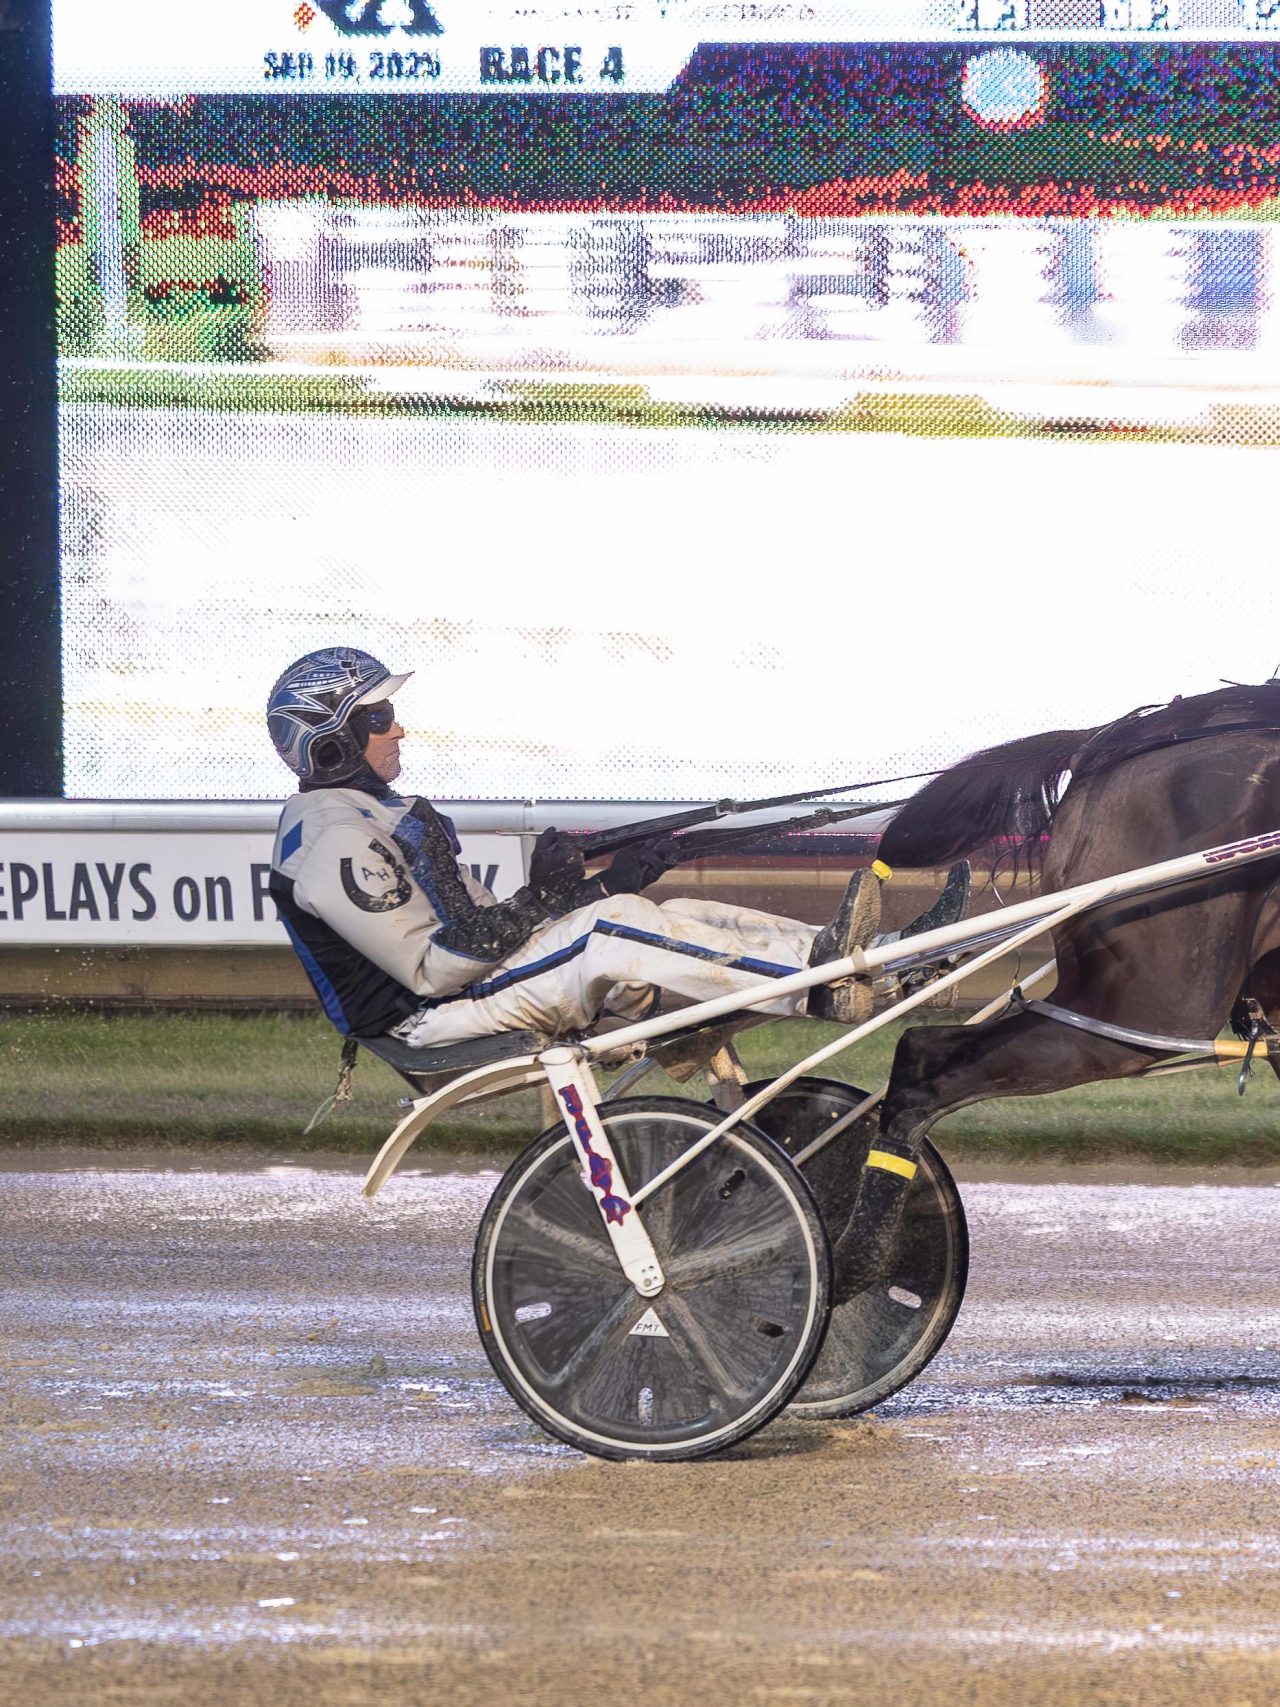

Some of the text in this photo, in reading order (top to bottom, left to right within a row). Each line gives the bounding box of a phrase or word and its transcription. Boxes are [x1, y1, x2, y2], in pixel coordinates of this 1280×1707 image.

[479, 46, 625, 84] RACE 4
[173, 876, 234, 921] on
